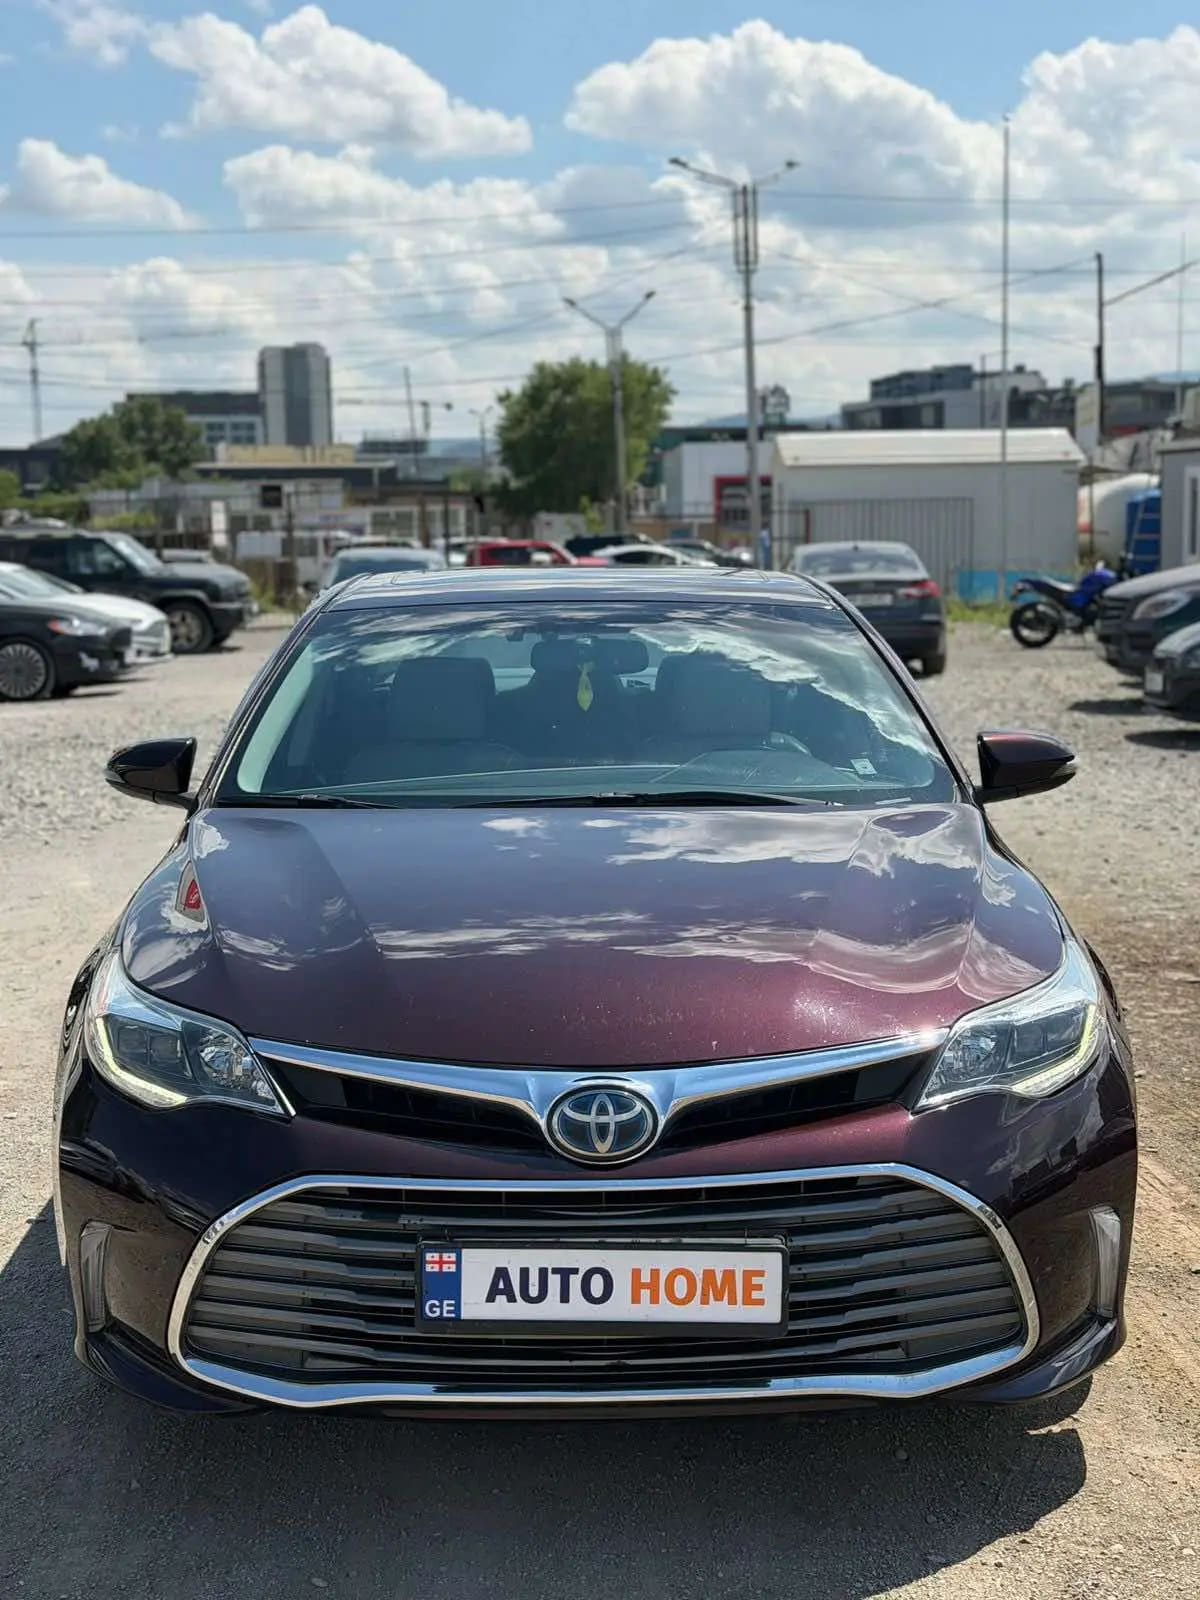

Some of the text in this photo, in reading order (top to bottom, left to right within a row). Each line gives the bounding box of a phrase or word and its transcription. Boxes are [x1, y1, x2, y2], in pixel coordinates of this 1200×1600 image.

[485, 1266, 766, 1307] AUTO HOME
[425, 1300, 456, 1318] GE
